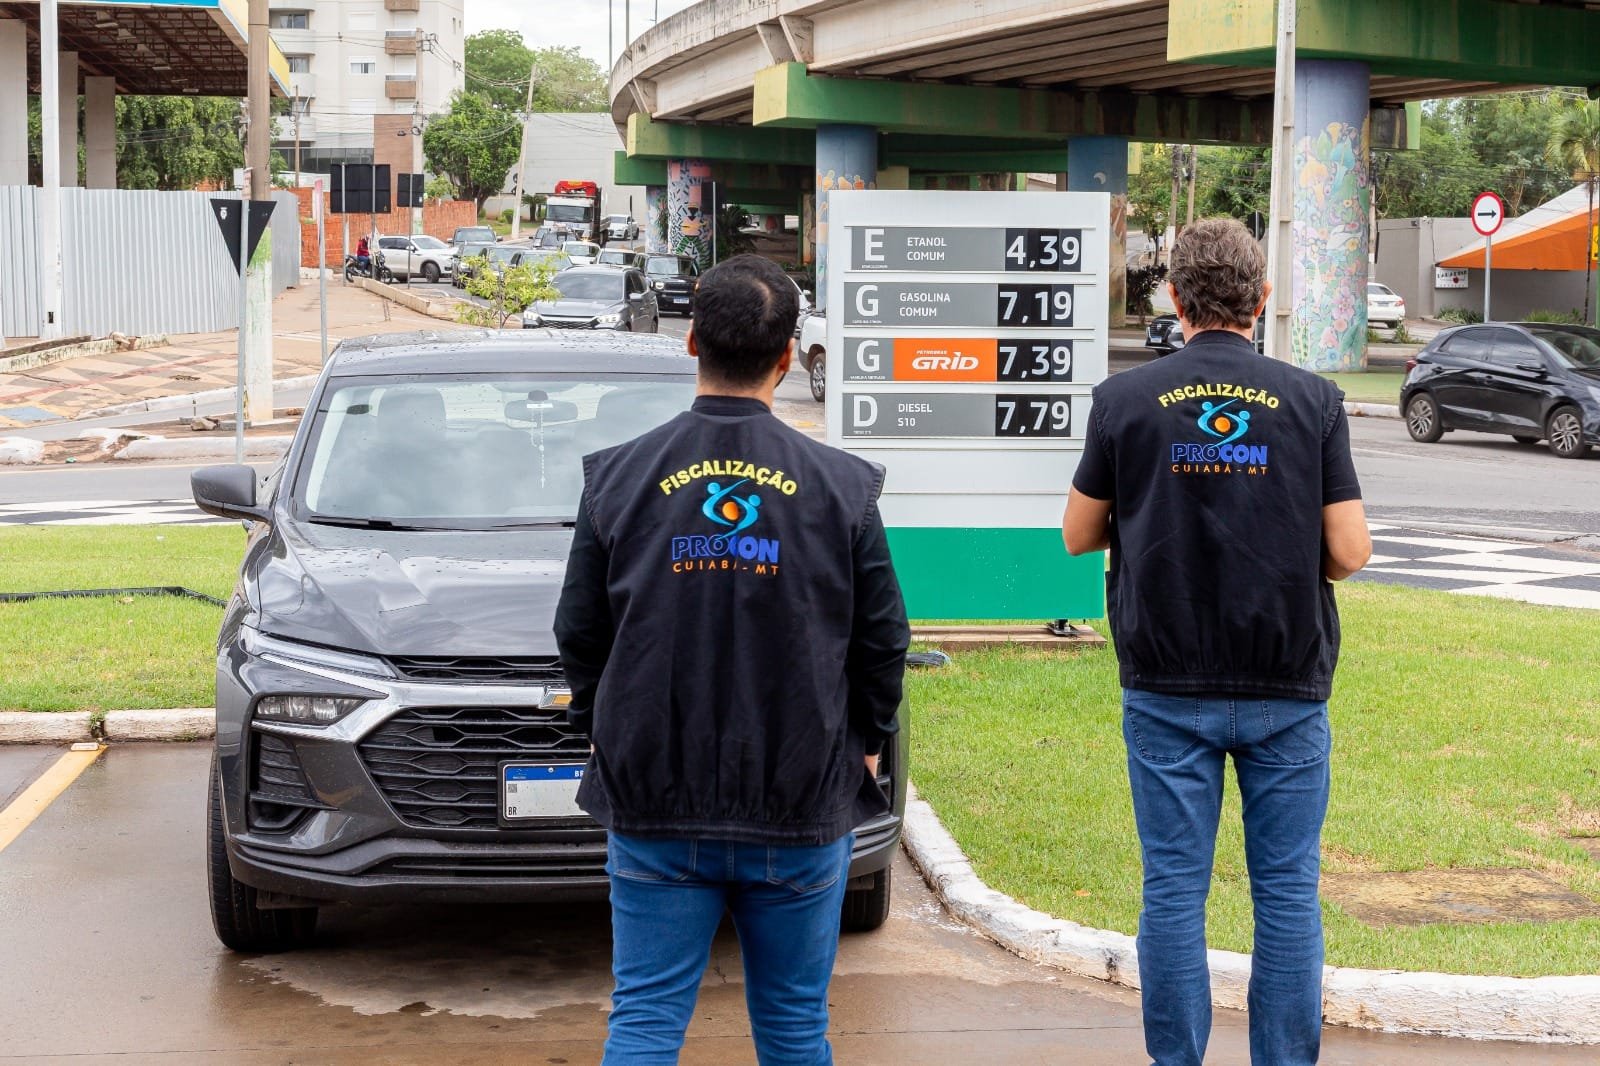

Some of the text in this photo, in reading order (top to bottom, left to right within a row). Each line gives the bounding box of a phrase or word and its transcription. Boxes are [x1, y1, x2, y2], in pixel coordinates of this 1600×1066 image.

[864, 228, 885, 262] E
[906, 236, 948, 247] ETANOL
[906, 251, 945, 261] COMUM
[1006, 235, 1080, 268] 4,39
[855, 284, 879, 317] G
[899, 292, 951, 303] GASOLINA
[899, 306, 938, 317] COMUM
[999, 291, 1072, 324] 7,19
[856, 339, 880, 373] G
[998, 345, 1071, 379] 7,39
[898, 403, 933, 413] DIESEL
[1158, 383, 1280, 409] FISCALIZAÇÃO
[853, 394, 878, 428] D
[897, 417, 916, 427] S10
[997, 400, 1070, 434] 7,79
[1171, 444, 1268, 464] PROCON
[659, 460, 797, 496] FISCALIZAÇÃO
[508, 806, 517, 815] BR
